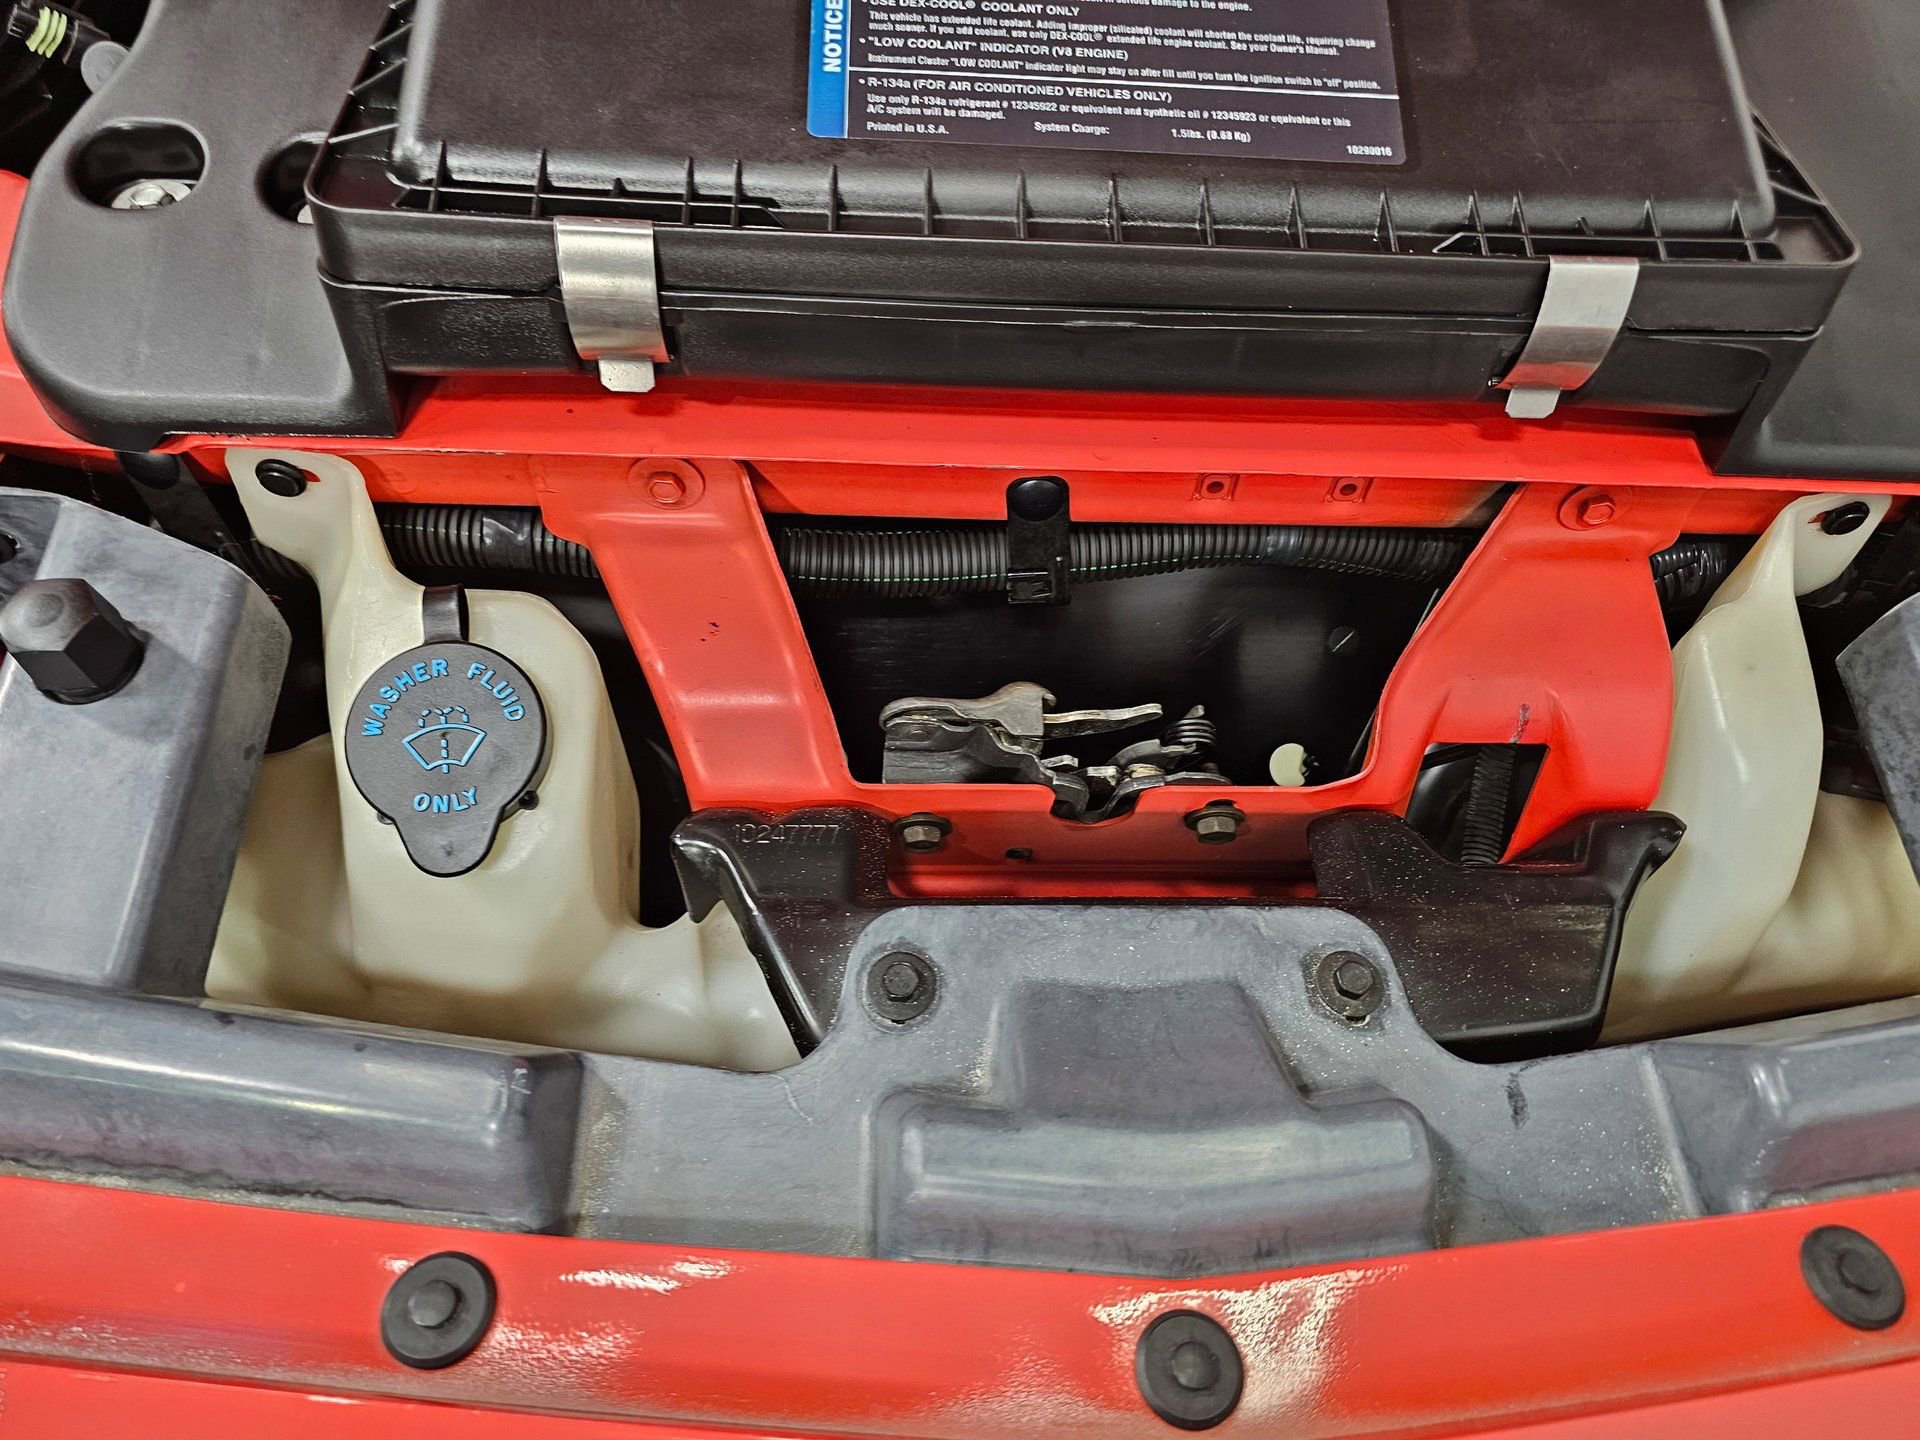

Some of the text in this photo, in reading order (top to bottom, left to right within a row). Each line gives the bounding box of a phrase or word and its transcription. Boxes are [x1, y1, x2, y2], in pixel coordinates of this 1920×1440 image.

[981, 1, 1043, 14] COOLANT
[1046, 5, 1080, 16] ONLY
[1190, 0, 1200, 8] to
[1201, 0, 1216, 9] the
[1217, 1, 1252, 11] engine.
[822, 0, 843, 73] NOTICE
[869, 11, 888, 21] This
[890, 12, 921, 22] vehicle
[923, 14, 940, 23] has
[941, 15, 981, 25] extended
[983, 17, 997, 26] life
[999, 18, 1034, 28] coolant.
[1036, 20, 1066, 31] Adding
[1068, 22, 1108, 33] improper
[1109, 24, 1153, 35] (silicated)
[1154, 26, 1186, 37] coolant
[1187, 28, 1203, 38] will
[1204, 30, 1236, 40] shorten
[1238, 31, 1252, 41] the
[1254, 33, 1285, 43] coolant
[1305, 36, 1344, 47] requiring
[1345, 38, 1376, 49] change
[869, 22, 893, 31] much
[930, 24, 937, 33] If
[938, 26, 955, 35] you
[956, 26, 973, 35] add
[1011, 30, 1028, 38] use
[1029, 30, 1048, 40] only
[1106, 35, 1146, 45] extended
[1147, 36, 1162, 46] life
[1164, 38, 1193, 48] engine
[1194, 39, 1229, 49] coolant.
[1230, 41, 1248, 51] See
[1249, 43, 1268, 52] your
[1270, 43, 1304, 54] Owner's
[1305, 45, 1340, 56] Manual.
[868, 36, 905, 48] "LOW
[907, 38, 977, 51] COOLANT"
[980, 42, 1050, 55] INDICATOR
[1074, 47, 1128, 61] ENGINE)
[867, 53, 916, 65] Instrument
[917, 55, 950, 66] Cluster
[951, 57, 976, 68] "LOW
[978, 58, 1024, 70] COOLANT"
[1025, 61, 1064, 72] indicator
[1065, 63, 1086, 74] light
[1087, 66, 1106, 75] may
[1108, 66, 1126, 77] stay
[1128, 68, 1139, 76] on
[1140, 67, 1161, 77] after
[1162, 68, 1175, 78] fill
[1176, 70, 1197, 79] until
[1198, 72, 1214, 81] you
[1215, 72, 1233, 81] turn
[1234, 72, 1248, 82] the
[1284, 76, 1312, 86] switch
[1313, 78, 1322, 87] to
[1343, 80, 1381, 89] position.
[867, 77, 1172, 104] R-134a (FOR AIR CONDITIONED VEHICLES ONLY)
[867, 93, 887, 103] Use
[888, 94, 909, 105] only
[911, 95, 946, 106] R-134a
[949, 98, 1000, 109] refrigerant
[1059, 104, 1070, 112] or
[1071, 104, 1122, 115] equivalent
[1124, 106, 1142, 116] and
[1143, 107, 1186, 118] synthetic
[1187, 109, 1200, 119] oil
[1258, 114, 1269, 122] or
[1270, 114, 1320, 125] equivalent
[1321, 117, 1332, 126] or
[1333, 117, 1351, 127] this
[867, 104, 1006, 120] A/C system will be damaged.
[866, 121, 949, 134] Printed in U.S.A.
[1034, 121, 1110, 135] System Charge:
[361, 657, 526, 737] WASHER FLUID
[413, 786, 478, 813] ONLY
